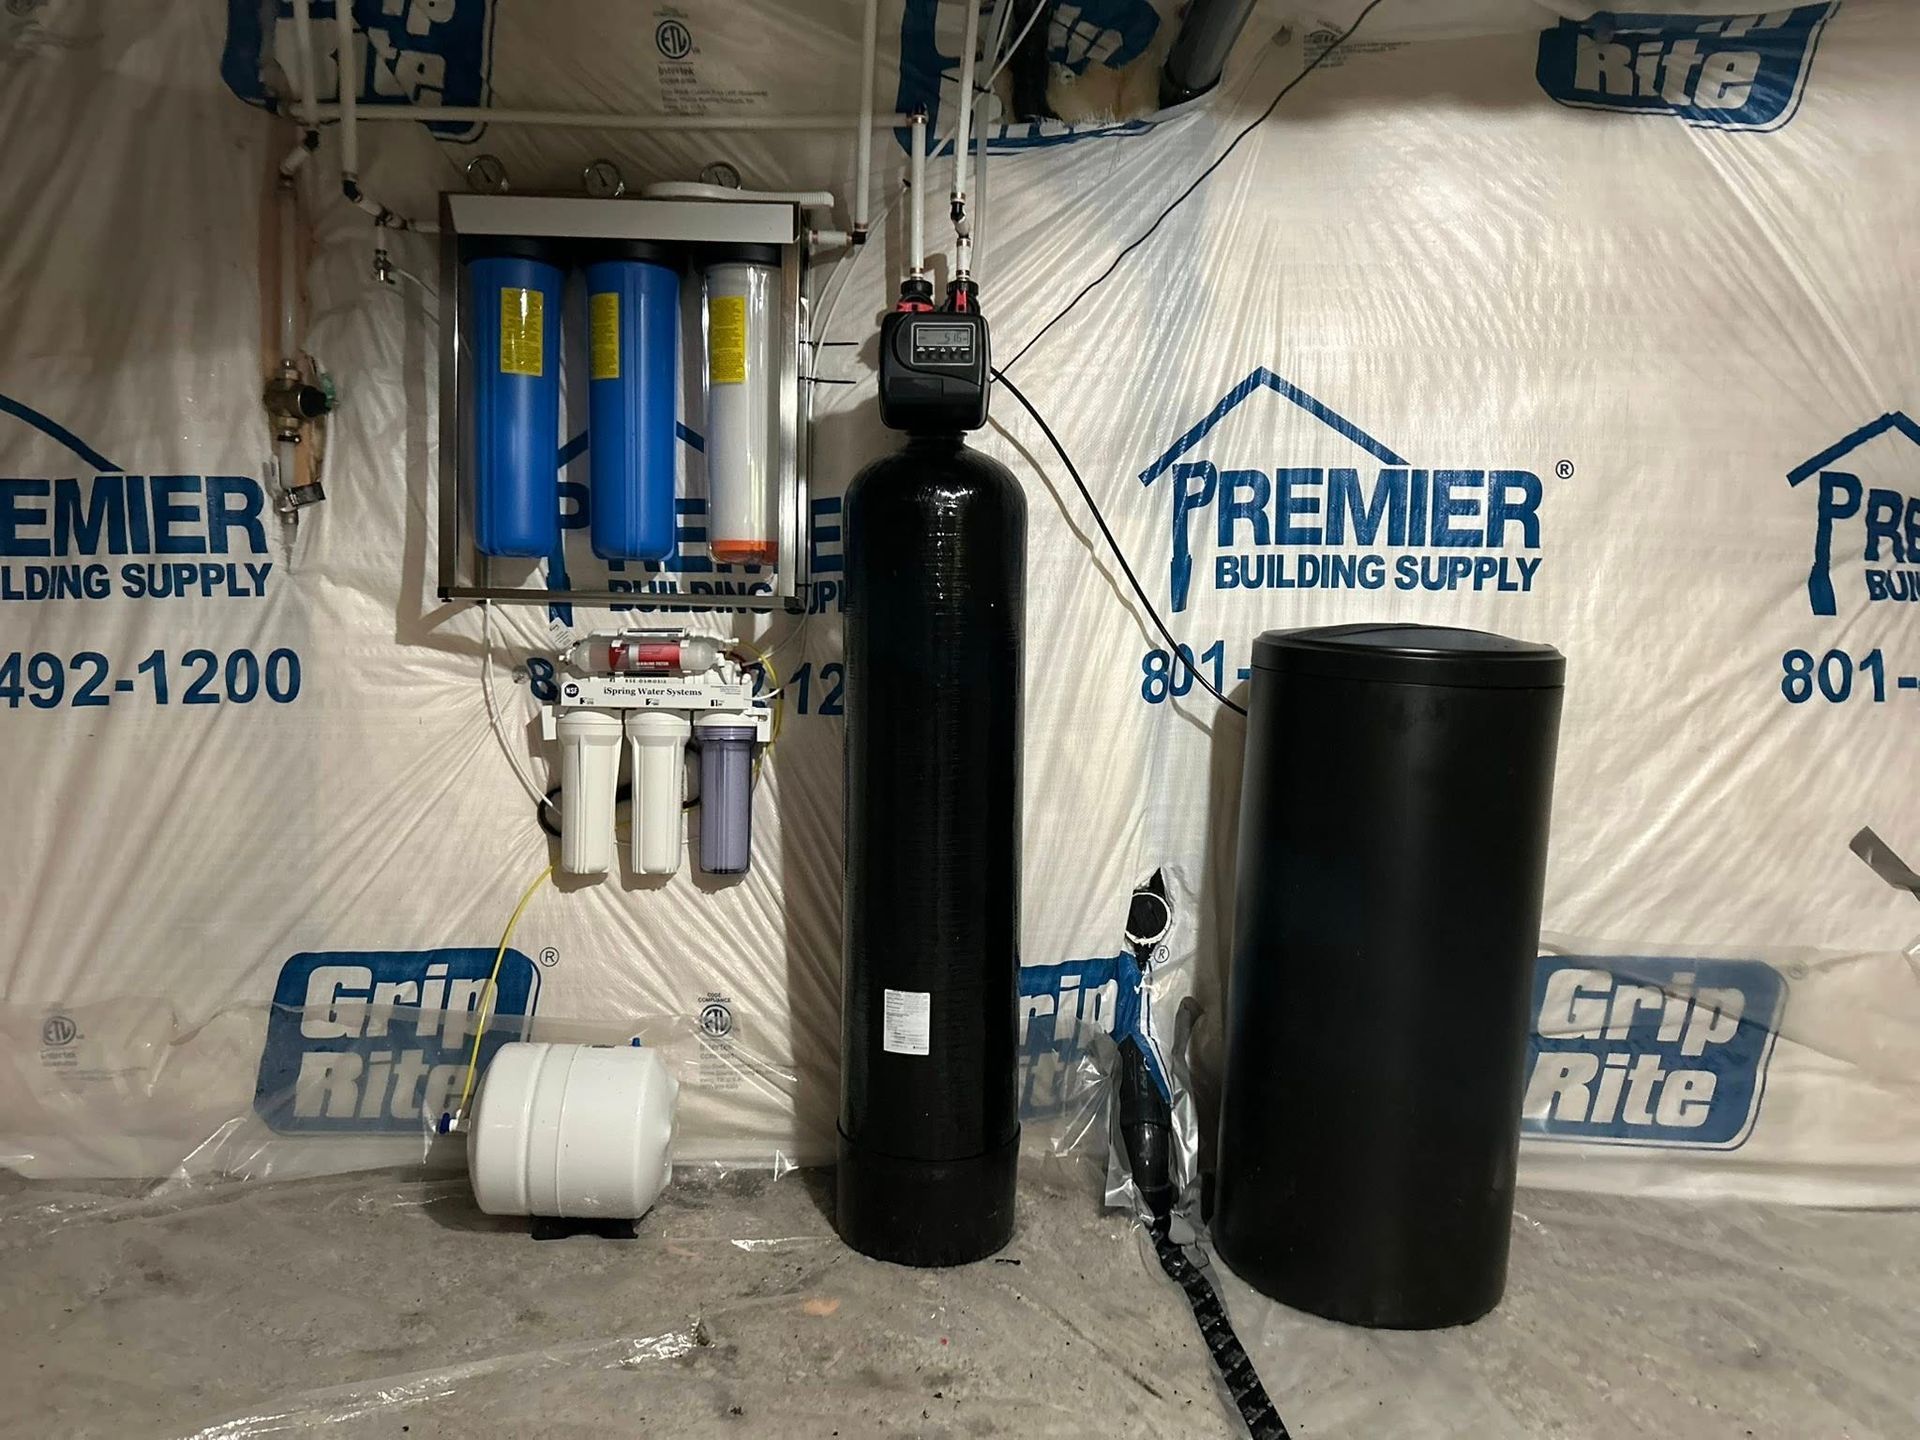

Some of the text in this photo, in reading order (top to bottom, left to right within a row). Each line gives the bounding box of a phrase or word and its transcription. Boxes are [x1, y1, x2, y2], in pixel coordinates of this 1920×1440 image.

[1574, 33, 1761, 109] Rite
[1172, 460, 1543, 549] PREMIER
[121, 562, 273, 598] SUPPLY
[1216, 554, 1543, 592] BUILDING SUPPLY
[1865, 569, 1920, 602] BUI
[565, 687, 579, 695] NSF
[603, 687, 636, 696] iSpring
[667, 688, 703, 697] Systems
[1782, 649, 1920, 703] 801-
[300, 963, 498, 1049] Grip
[1537, 968, 1745, 1056] Grip
[293, 1049, 478, 1120] Rite
[1522, 1052, 1717, 1127] Rite
